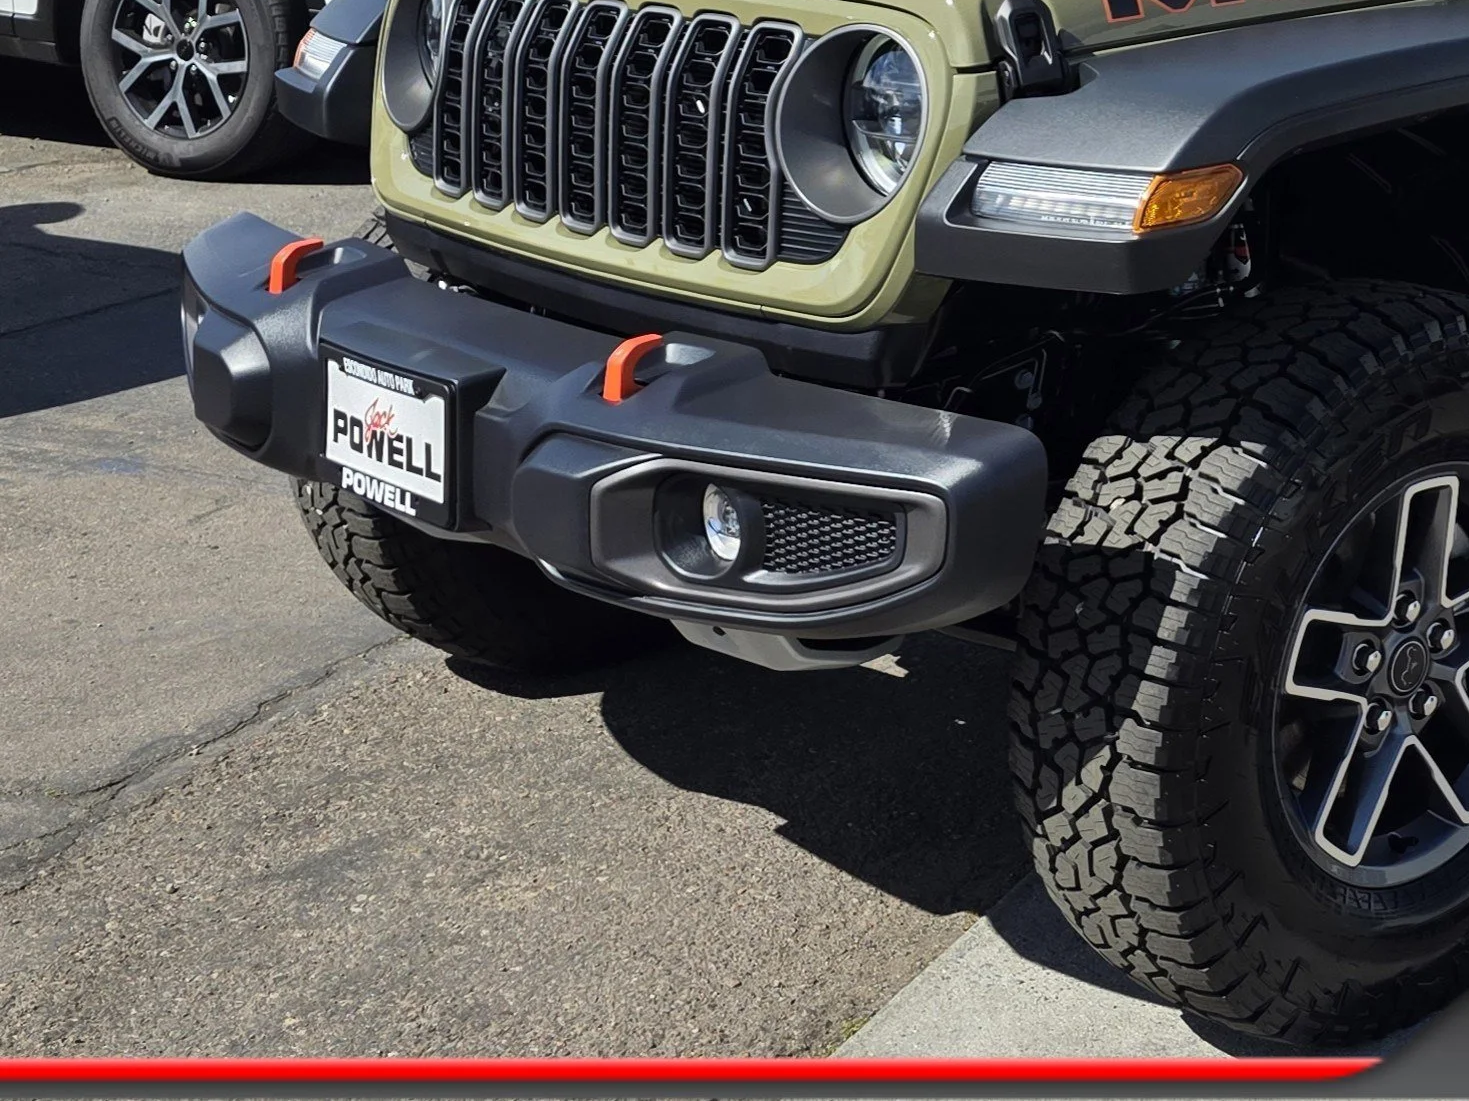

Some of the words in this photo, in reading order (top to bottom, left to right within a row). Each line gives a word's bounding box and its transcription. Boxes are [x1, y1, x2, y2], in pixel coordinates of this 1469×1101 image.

[364, 397, 399, 443] Jack
[333, 408, 442, 484] POWELL
[341, 466, 417, 517] POWELL
